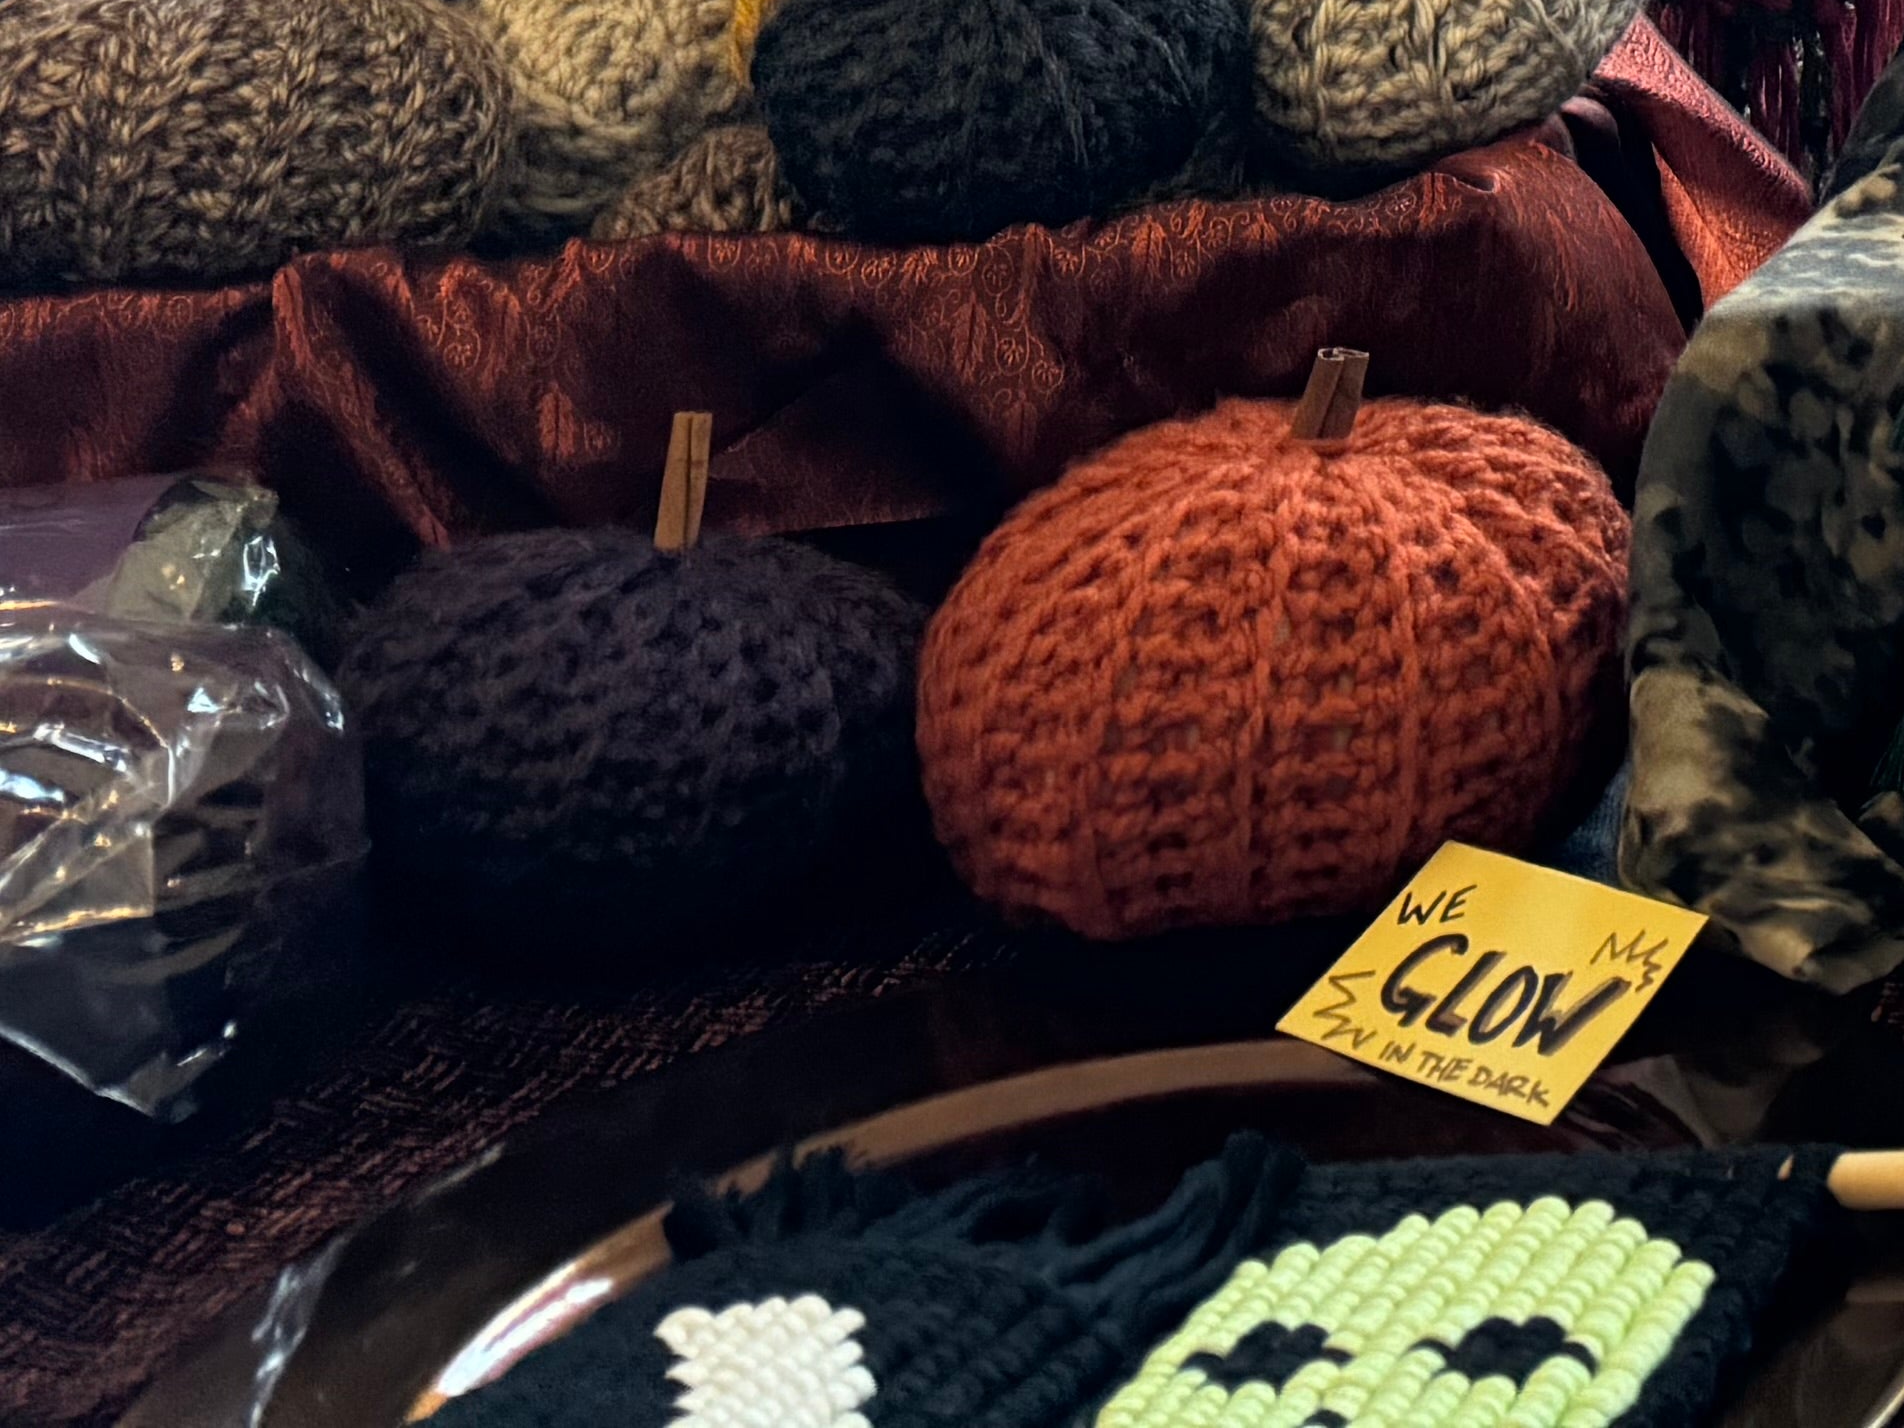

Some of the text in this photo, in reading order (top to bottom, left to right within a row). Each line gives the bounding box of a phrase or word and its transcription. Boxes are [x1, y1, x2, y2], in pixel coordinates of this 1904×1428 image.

[1397, 884, 1478, 926] WE
[1380, 933, 1632, 1058] GLOW
[1379, 1040, 1552, 1108] IN THE DARK
